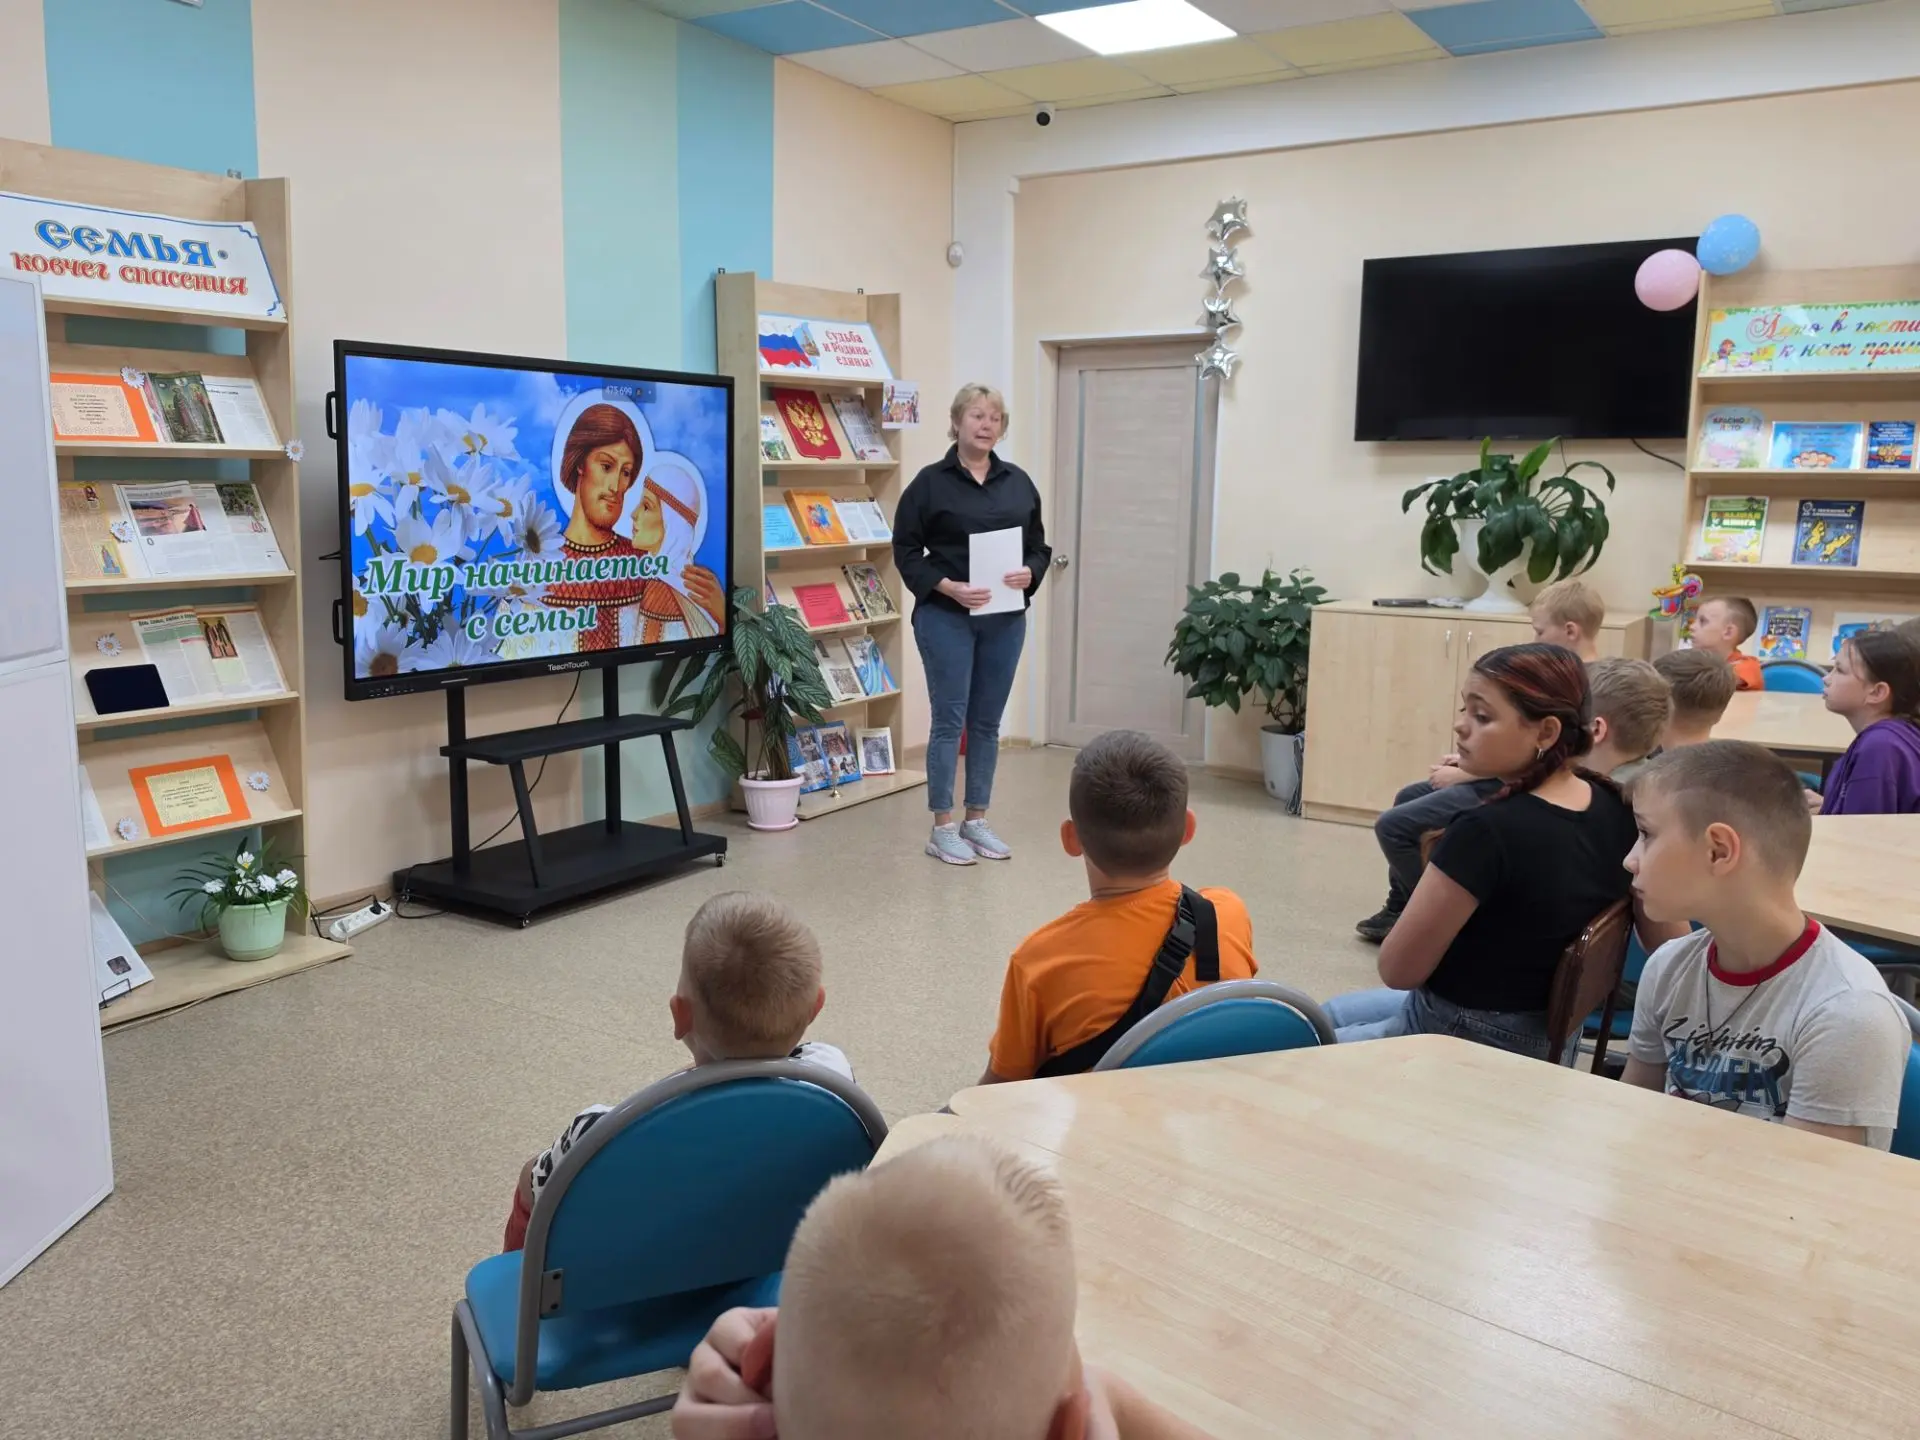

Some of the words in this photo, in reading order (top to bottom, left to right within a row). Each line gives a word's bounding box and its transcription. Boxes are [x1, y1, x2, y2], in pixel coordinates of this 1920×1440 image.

[10, 252, 111, 280] ковчег
[119, 264, 249, 296] спасения
[364, 558, 455, 600] Мир
[465, 554, 670, 589] начинается
[467, 615, 486, 640] с
[495, 603, 597, 637] семьи
[548, 660, 590, 671] TeachTouch
